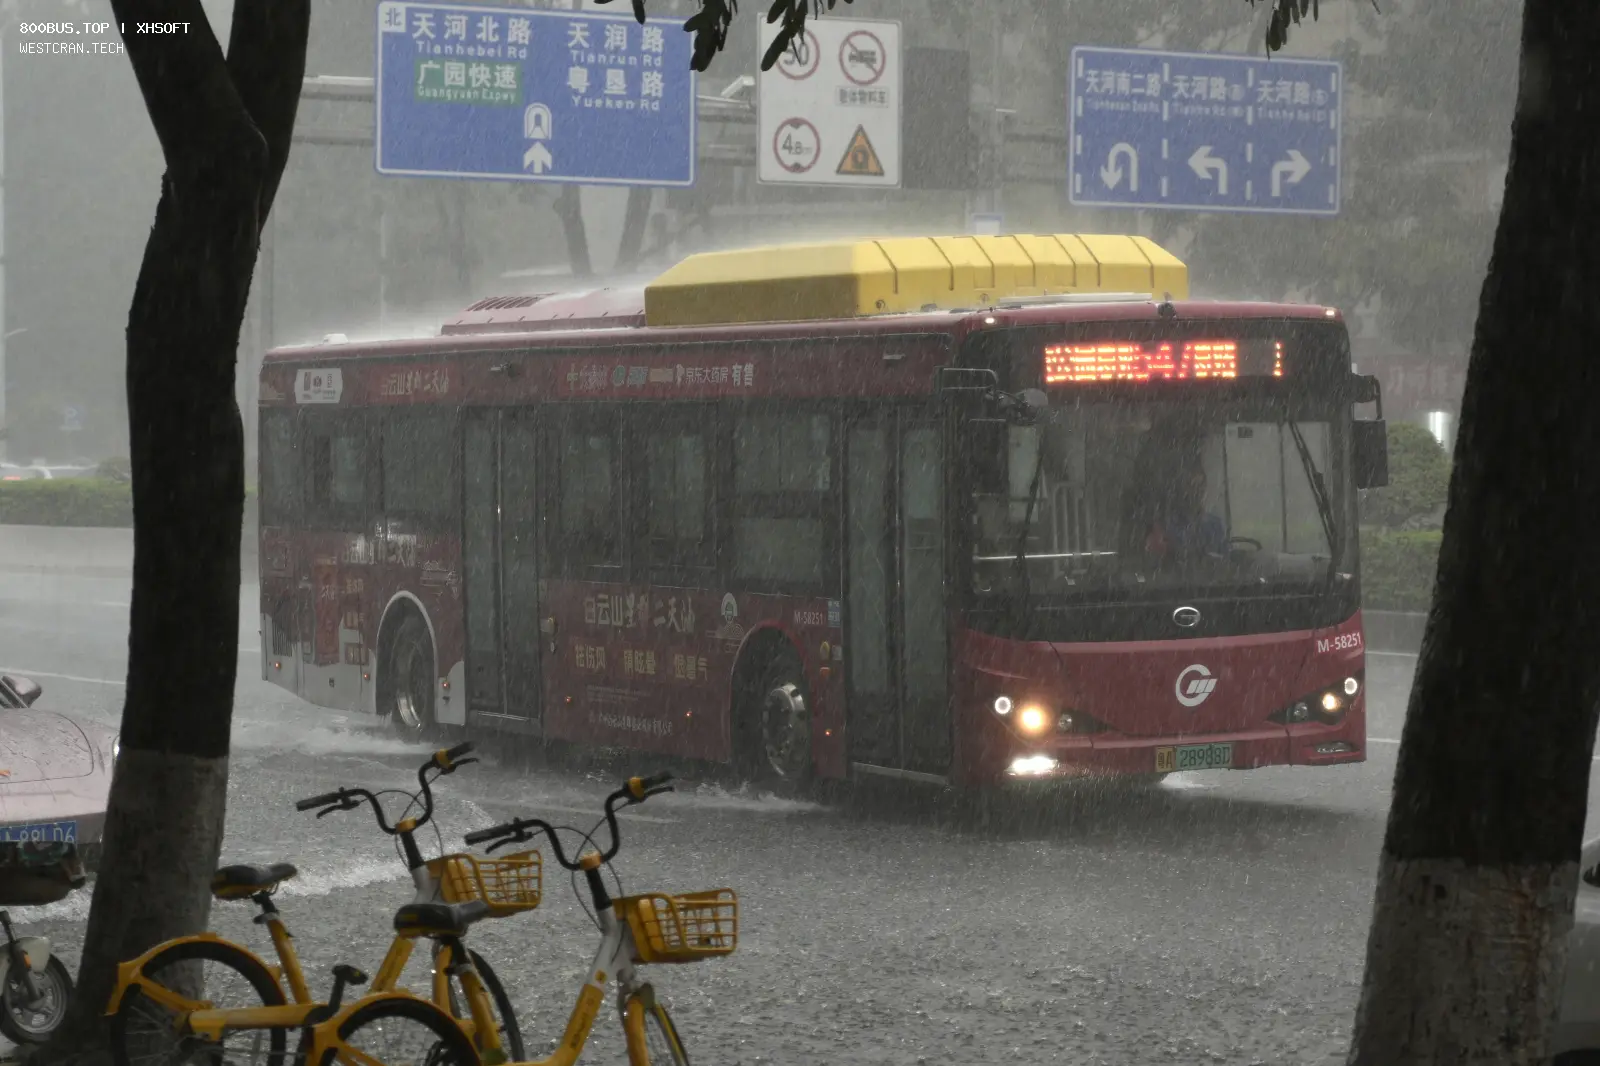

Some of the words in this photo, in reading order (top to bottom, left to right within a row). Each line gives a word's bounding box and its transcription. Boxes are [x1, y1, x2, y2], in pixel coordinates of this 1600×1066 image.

[384, 7, 401, 26] 北
[412, 13, 532, 46] 天河北路
[567, 21, 665, 53] 天润路
[416, 40, 502, 58] Tianhebei
[507, 46, 527, 60] Rd
[570, 50, 637, 66] Tianrun
[643, 54, 662, 67] Rd
[417, 60, 517, 89] 广园快速
[566, 66, 665, 97] 粤垦路
[571, 95, 635, 109] Yueken
[640, 98, 660, 111] Rd
[731, 362, 755, 388] 有售
[793, 609, 824, 626] M-58251
[1316, 631, 1362, 654] M-58251
